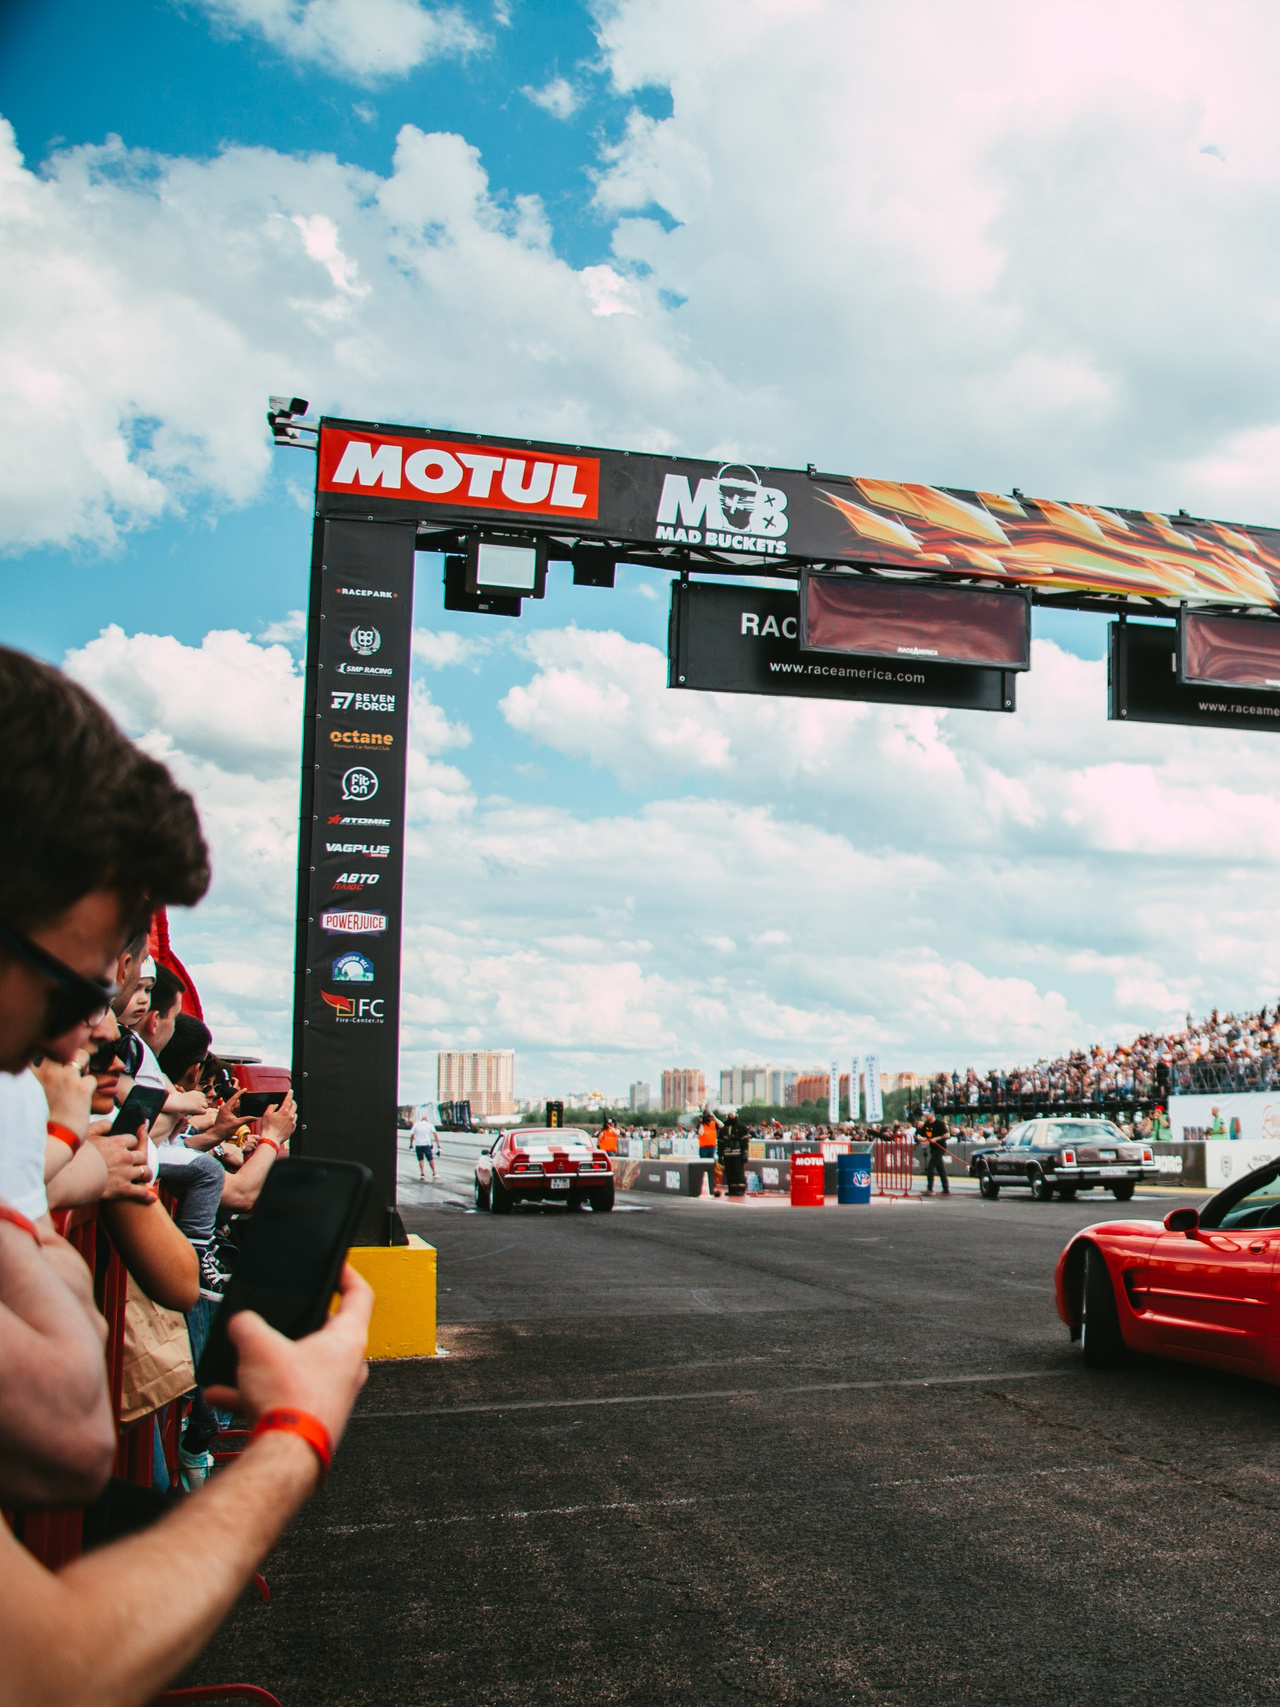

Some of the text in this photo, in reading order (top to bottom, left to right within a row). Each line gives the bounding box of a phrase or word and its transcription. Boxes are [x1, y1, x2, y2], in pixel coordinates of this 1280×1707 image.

[332, 440, 588, 509] MOTUL
[655, 525, 788, 555] MAD BUCKETS
[341, 587, 393, 599] RACEPARK
[346, 665, 393, 675] SMP RACING
[769, 661, 926, 684] www.raceamerica.com
[355, 693, 396, 703] SEVEN
[355, 701, 396, 712] FORCE
[329, 729, 394, 746] octane
[350, 784, 368, 796] on
[339, 816, 392, 825] ATOMIC
[325, 842, 391, 854] VAGPLUS
[336, 872, 381, 885] АВТО
[332, 882, 364, 891] ПЛЮС
[326, 914, 385, 930] POWERJUICE
[358, 998, 385, 1017] FC
